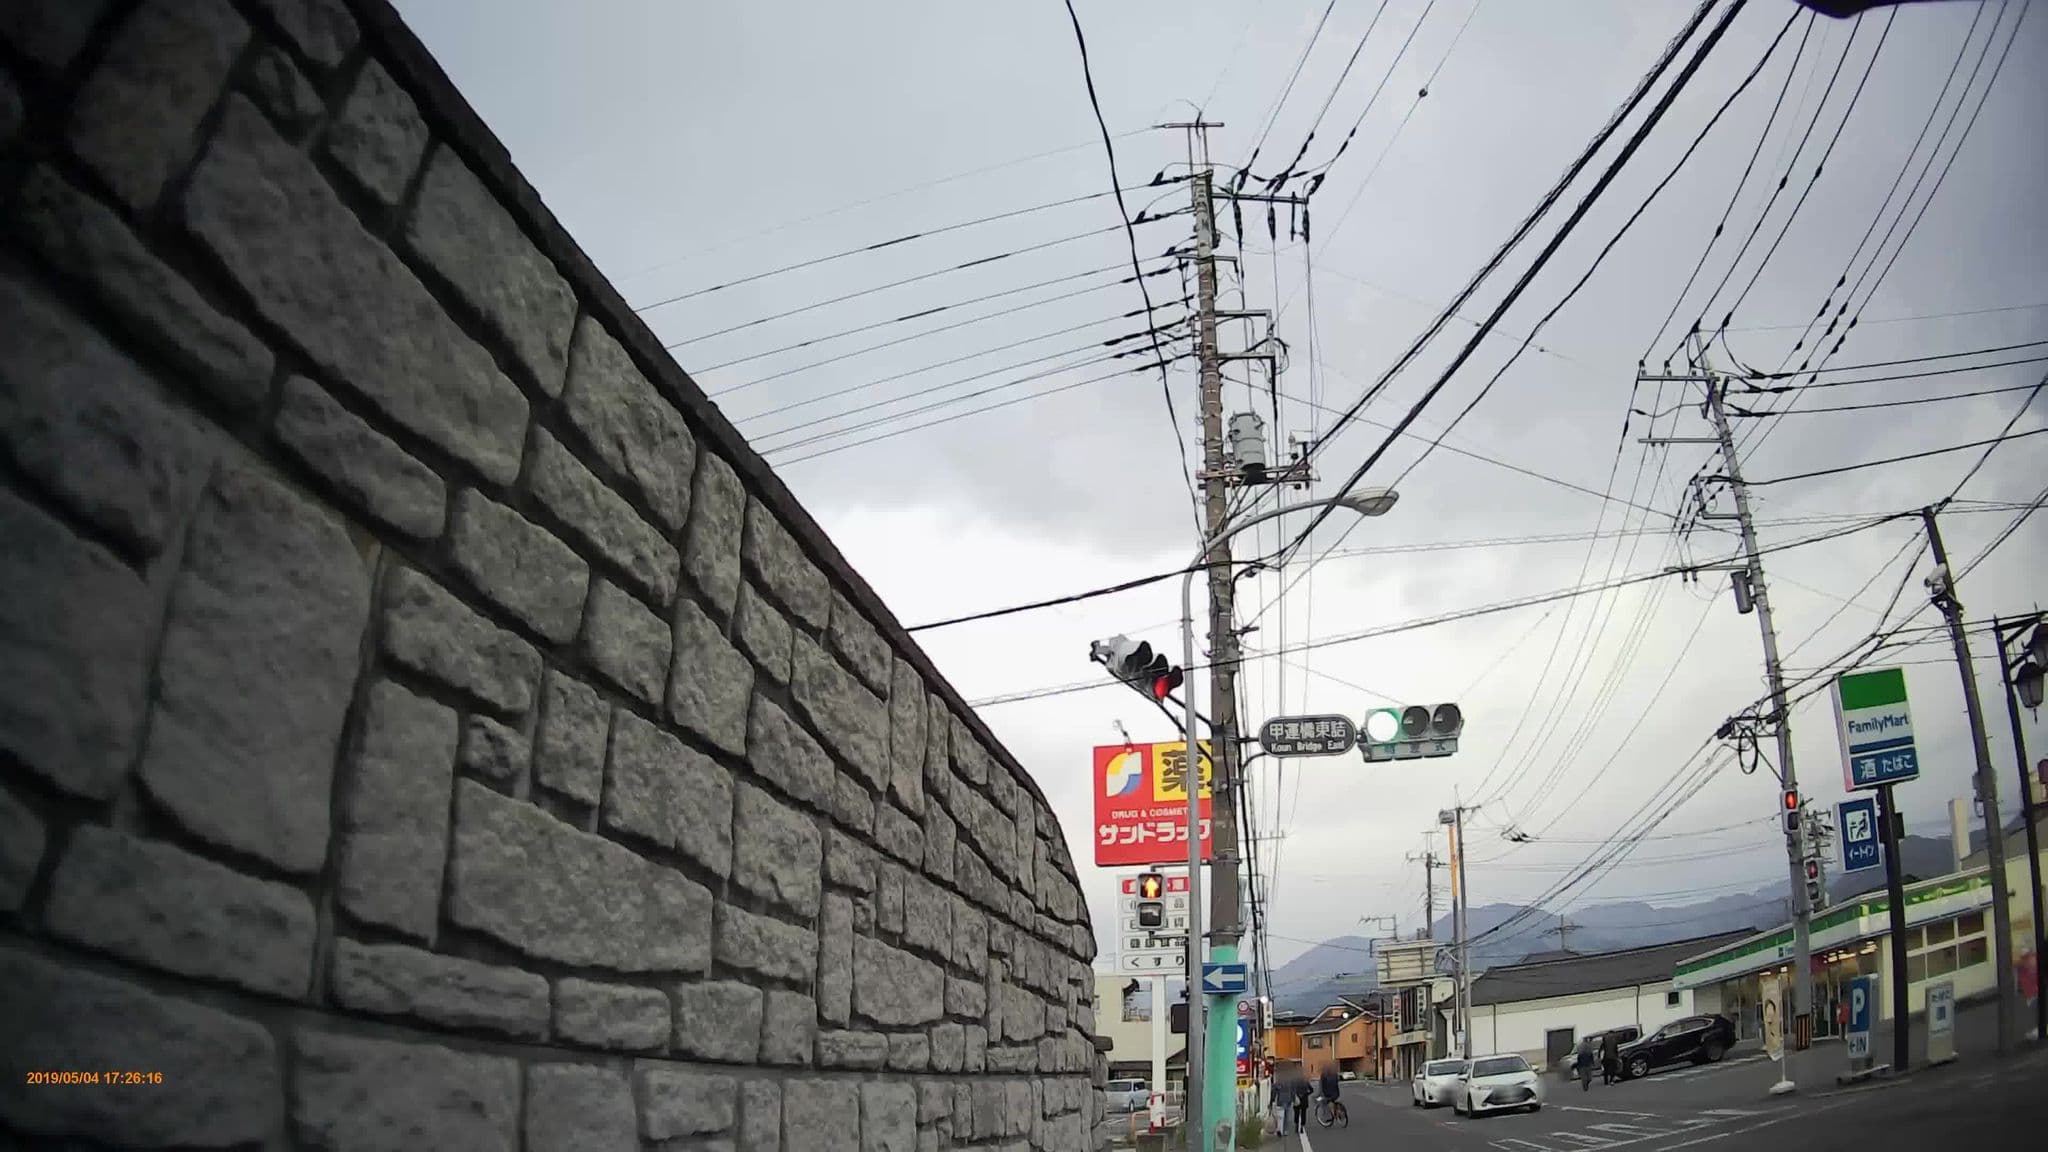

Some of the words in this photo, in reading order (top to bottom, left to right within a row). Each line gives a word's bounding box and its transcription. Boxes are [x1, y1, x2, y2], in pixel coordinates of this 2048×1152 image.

[1269, 721, 1346, 740] 甲運橋東詰
[1848, 712, 1909, 733] FamilyMart
[1271, 743, 1292, 752] Koun
[1297, 741, 1322, 752] Bridge
[1161, 750, 1205, 792] 薬
[1860, 758, 1877, 779] 酒
[1882, 754, 1914, 773] たばこ
[1112, 810, 1138, 819] DRUG
[1150, 806, 1189, 817] COSMET
[1131, 955, 1185, 968] くすり
[1852, 988, 1866, 1025] P
